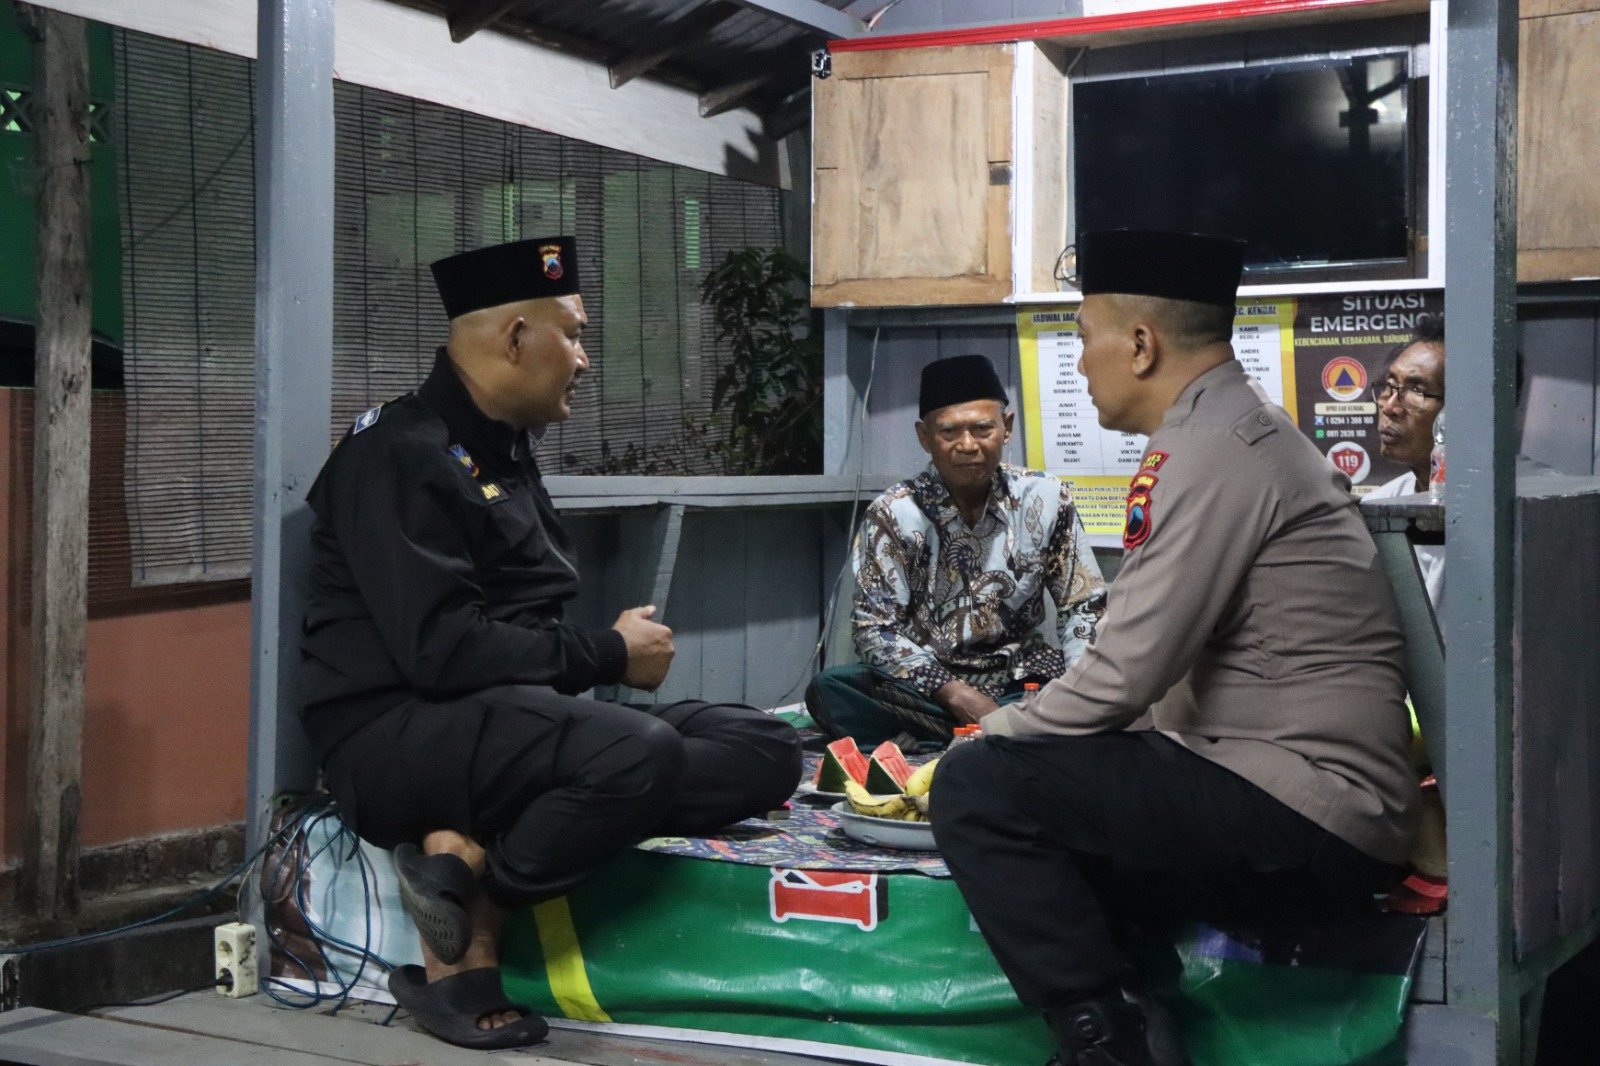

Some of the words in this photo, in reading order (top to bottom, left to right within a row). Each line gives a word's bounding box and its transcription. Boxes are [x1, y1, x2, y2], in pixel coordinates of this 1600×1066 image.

[1343, 293, 1426, 311] SITUASI
[1247, 305, 1277, 315] KENDAL
[1033, 313, 1062, 323] JADWAL
[1310, 312, 1443, 333] EMERGENC
[1337, 454, 1359, 468] 119
